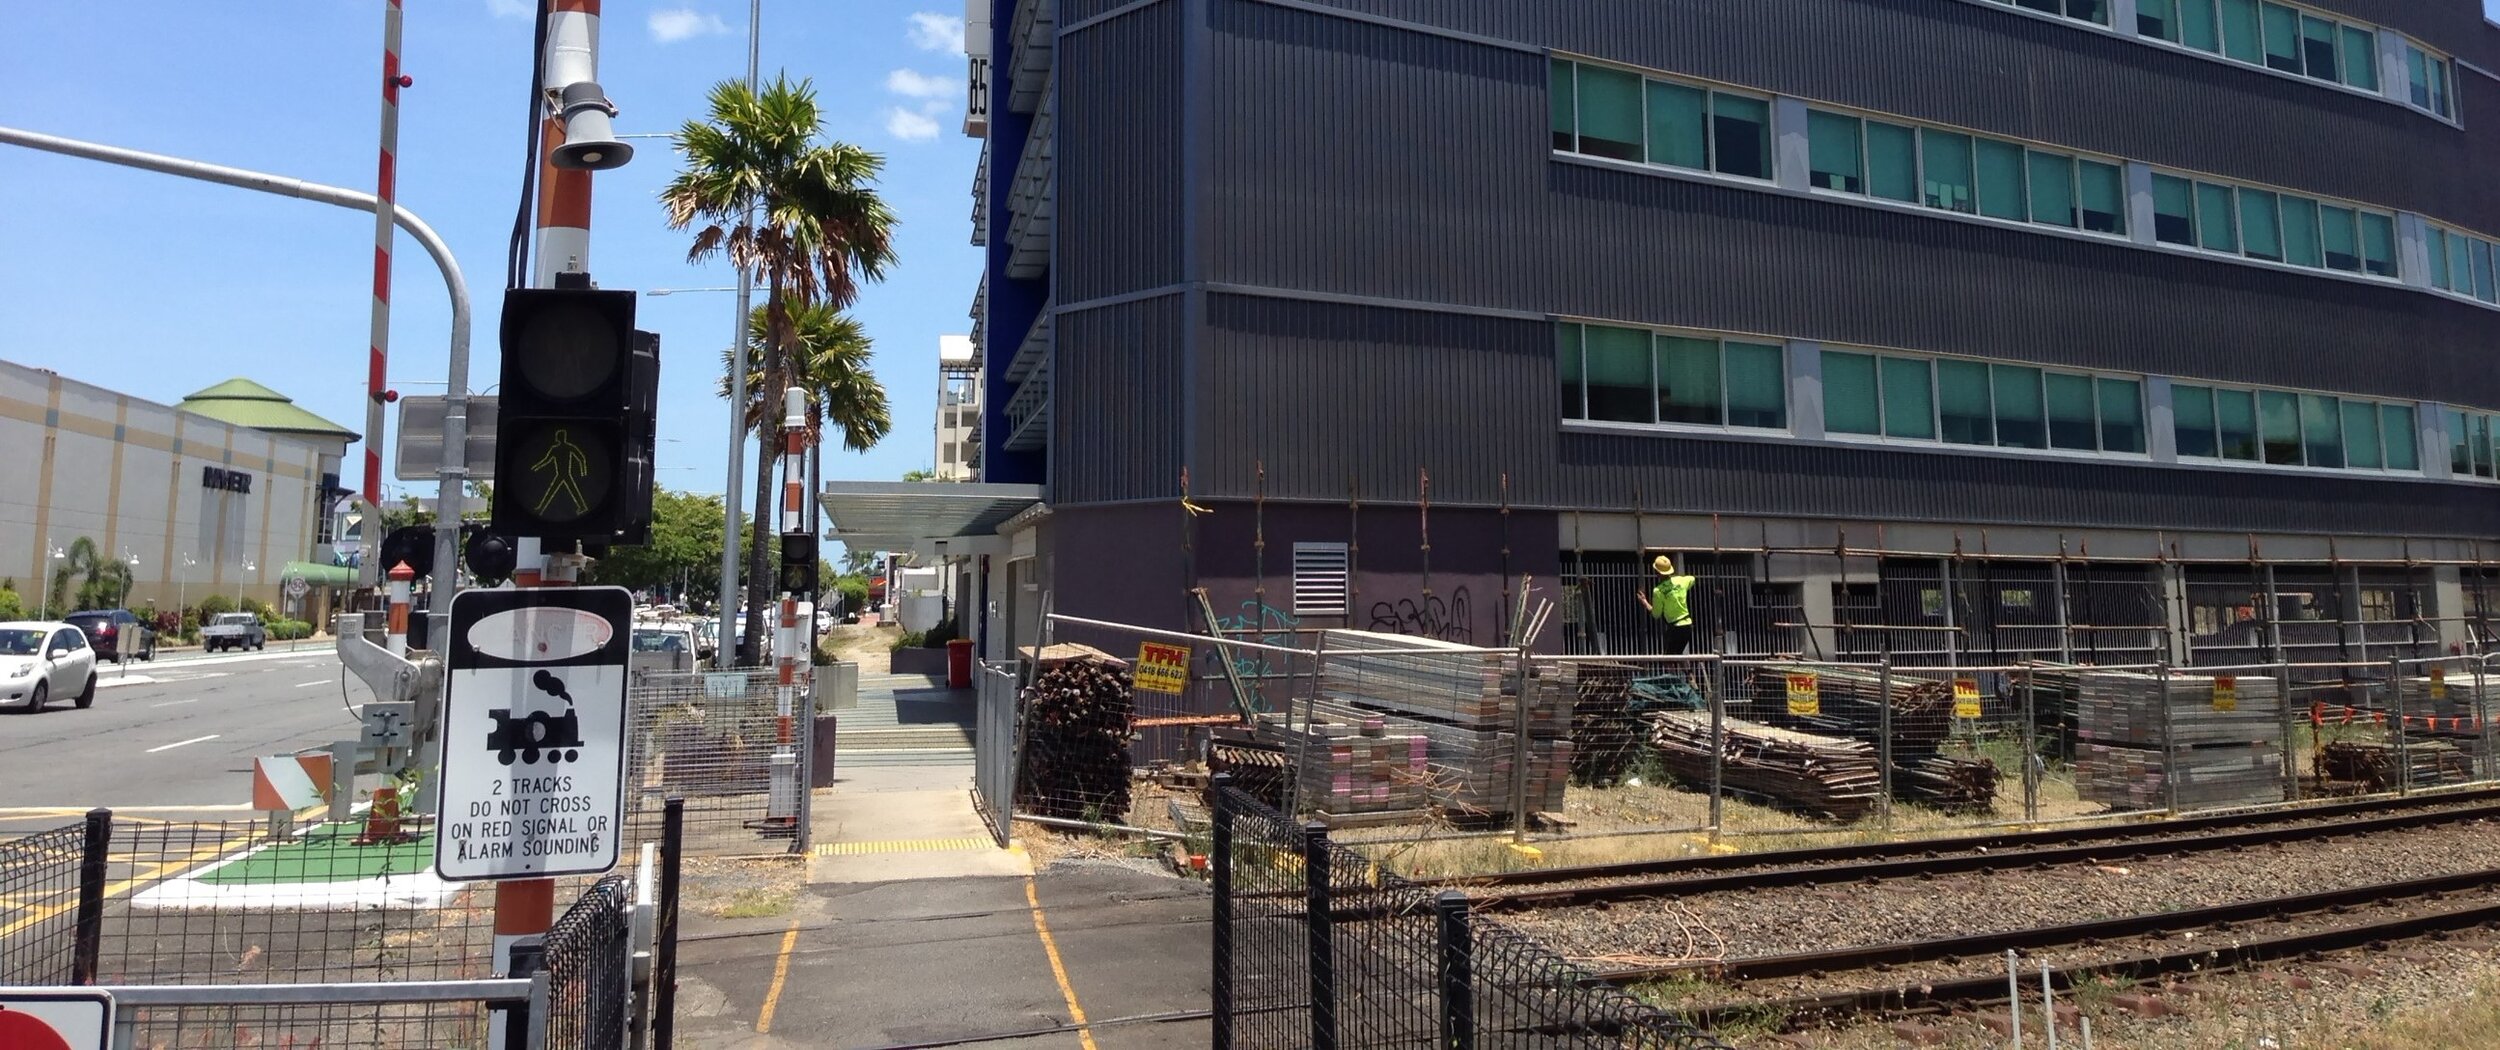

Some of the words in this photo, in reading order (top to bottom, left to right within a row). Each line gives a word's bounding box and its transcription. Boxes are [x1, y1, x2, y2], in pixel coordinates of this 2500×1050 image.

[969, 58, 988, 115] 85
[1144, 645, 1182, 667] TFH
[492, 779, 502, 796] 2
[512, 776, 573, 794] TRACKS
[470, 801, 491, 818] DO
[500, 799, 531, 816] NOT
[540, 795, 591, 814] CROSS
[451, 823, 472, 840] ON
[481, 821, 512, 838] RED
[521, 817, 578, 836] SIGNAL
[587, 815, 608, 832] OR
[457, 841, 513, 861] ALARM
[522, 836, 600, 857] SOUNDING
